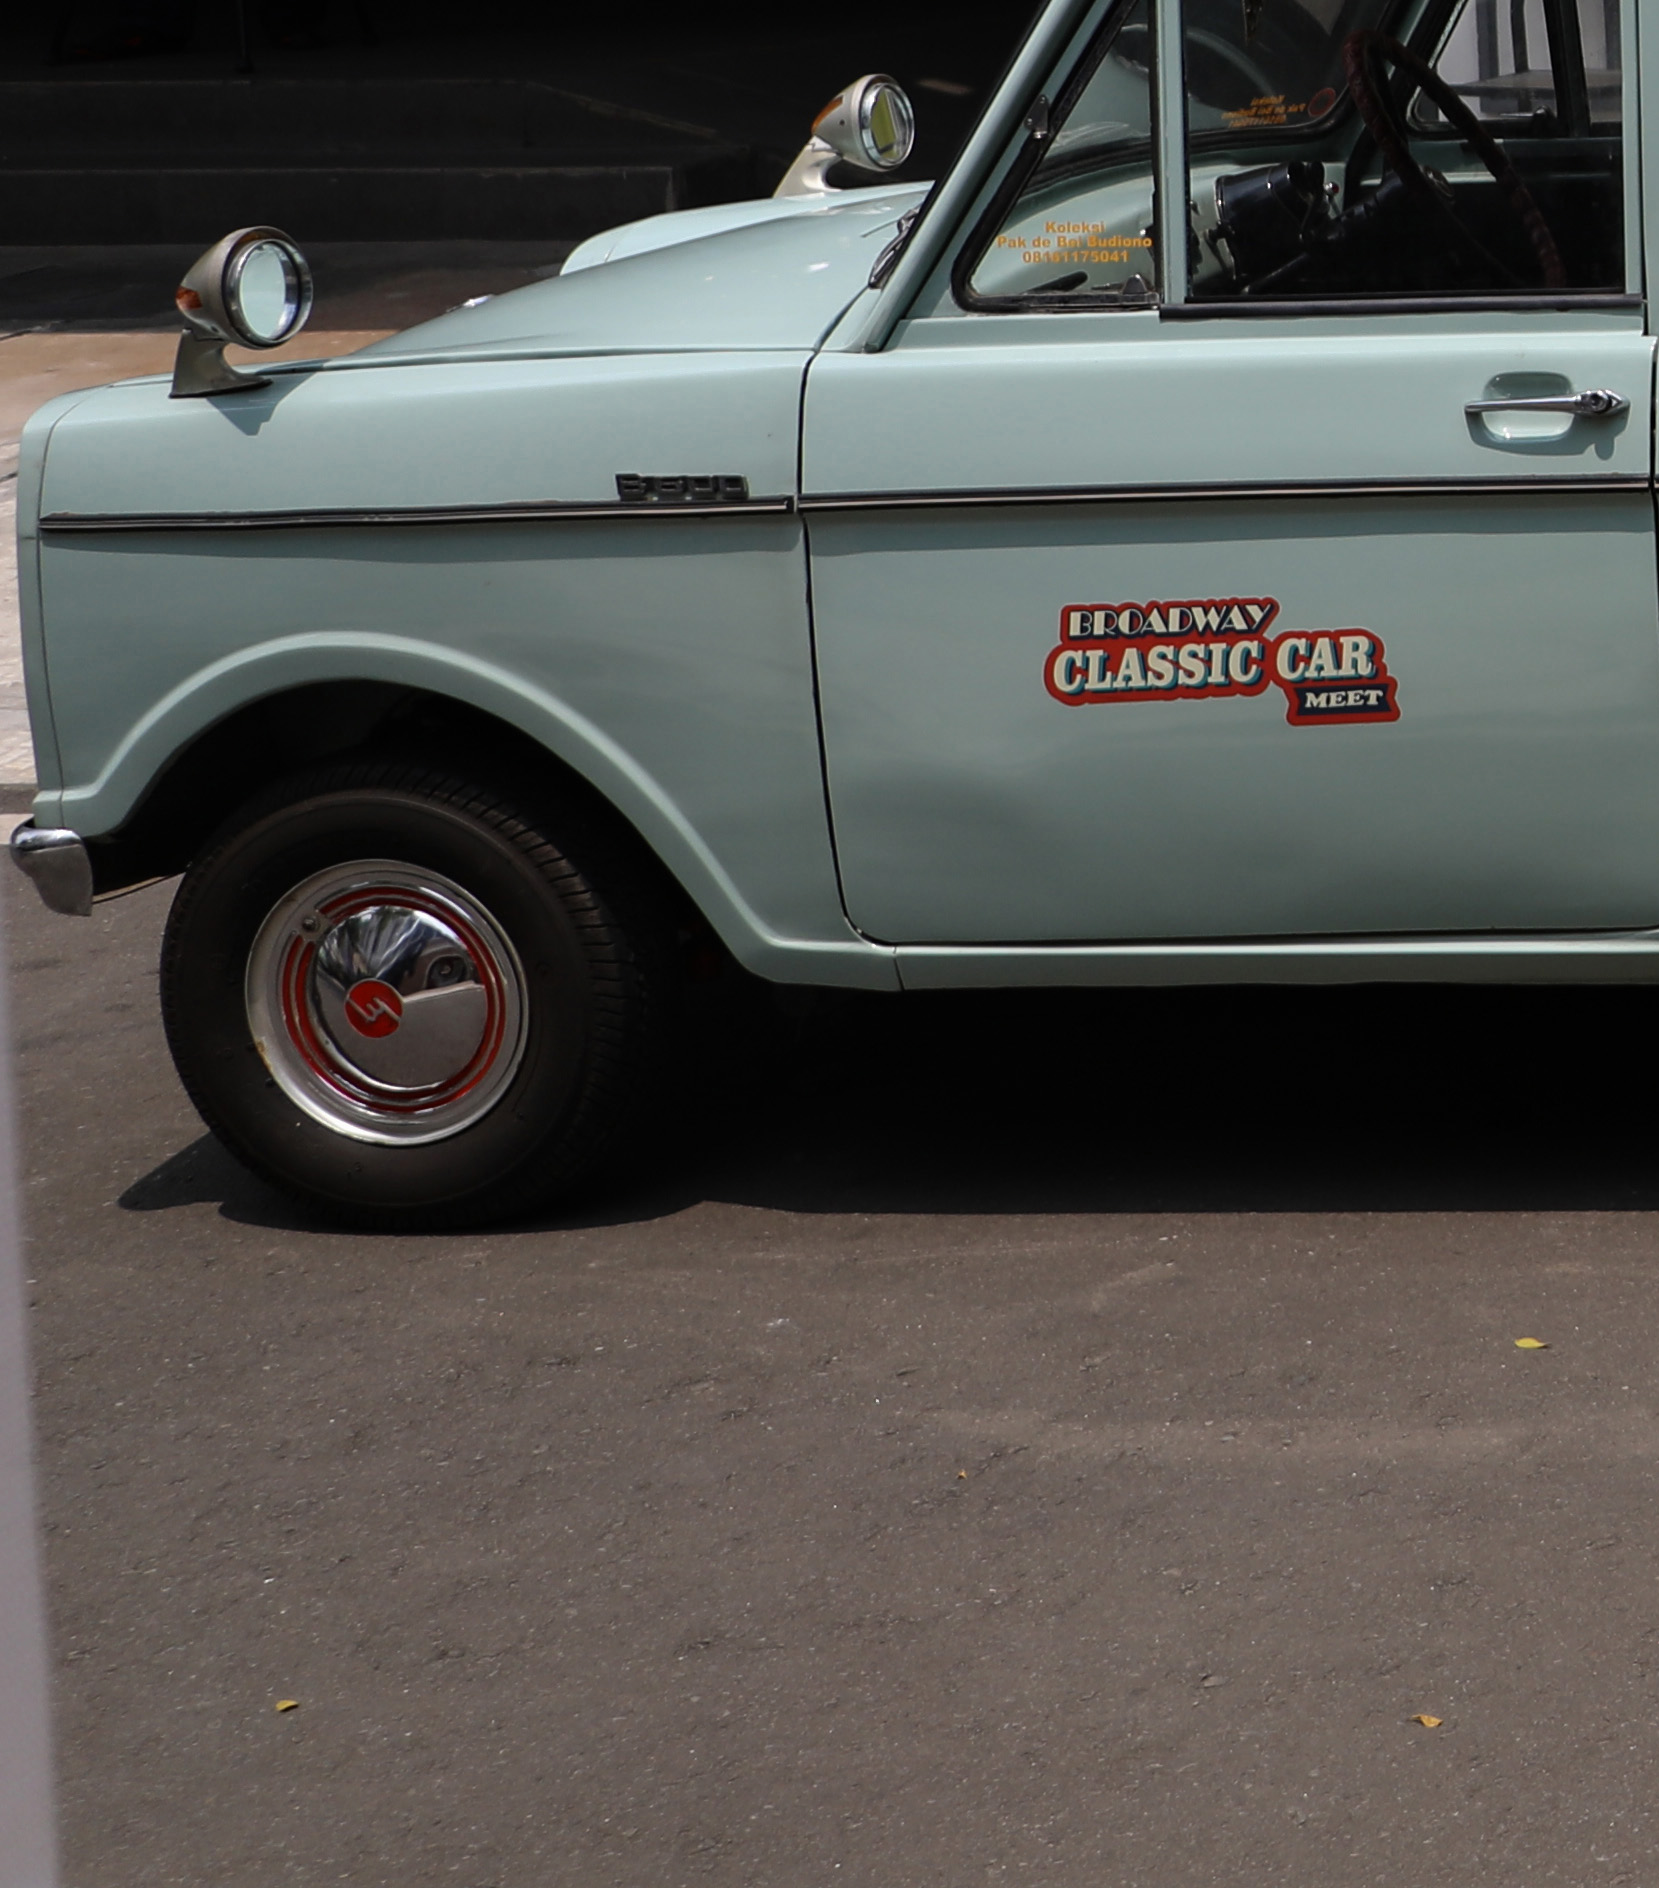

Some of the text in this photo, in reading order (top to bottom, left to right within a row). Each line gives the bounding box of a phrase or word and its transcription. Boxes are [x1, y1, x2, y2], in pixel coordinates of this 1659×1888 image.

[1045, 220, 1105, 234] Koleksi
[996, 235, 1152, 249] Pak de Bei Budiono
[1022, 250, 1129, 264] 08161175041
[1068, 604, 1273, 638] BROADWAY
[1053, 634, 1375, 693] CLASSIC CAR
[1304, 689, 1384, 709] MEET
